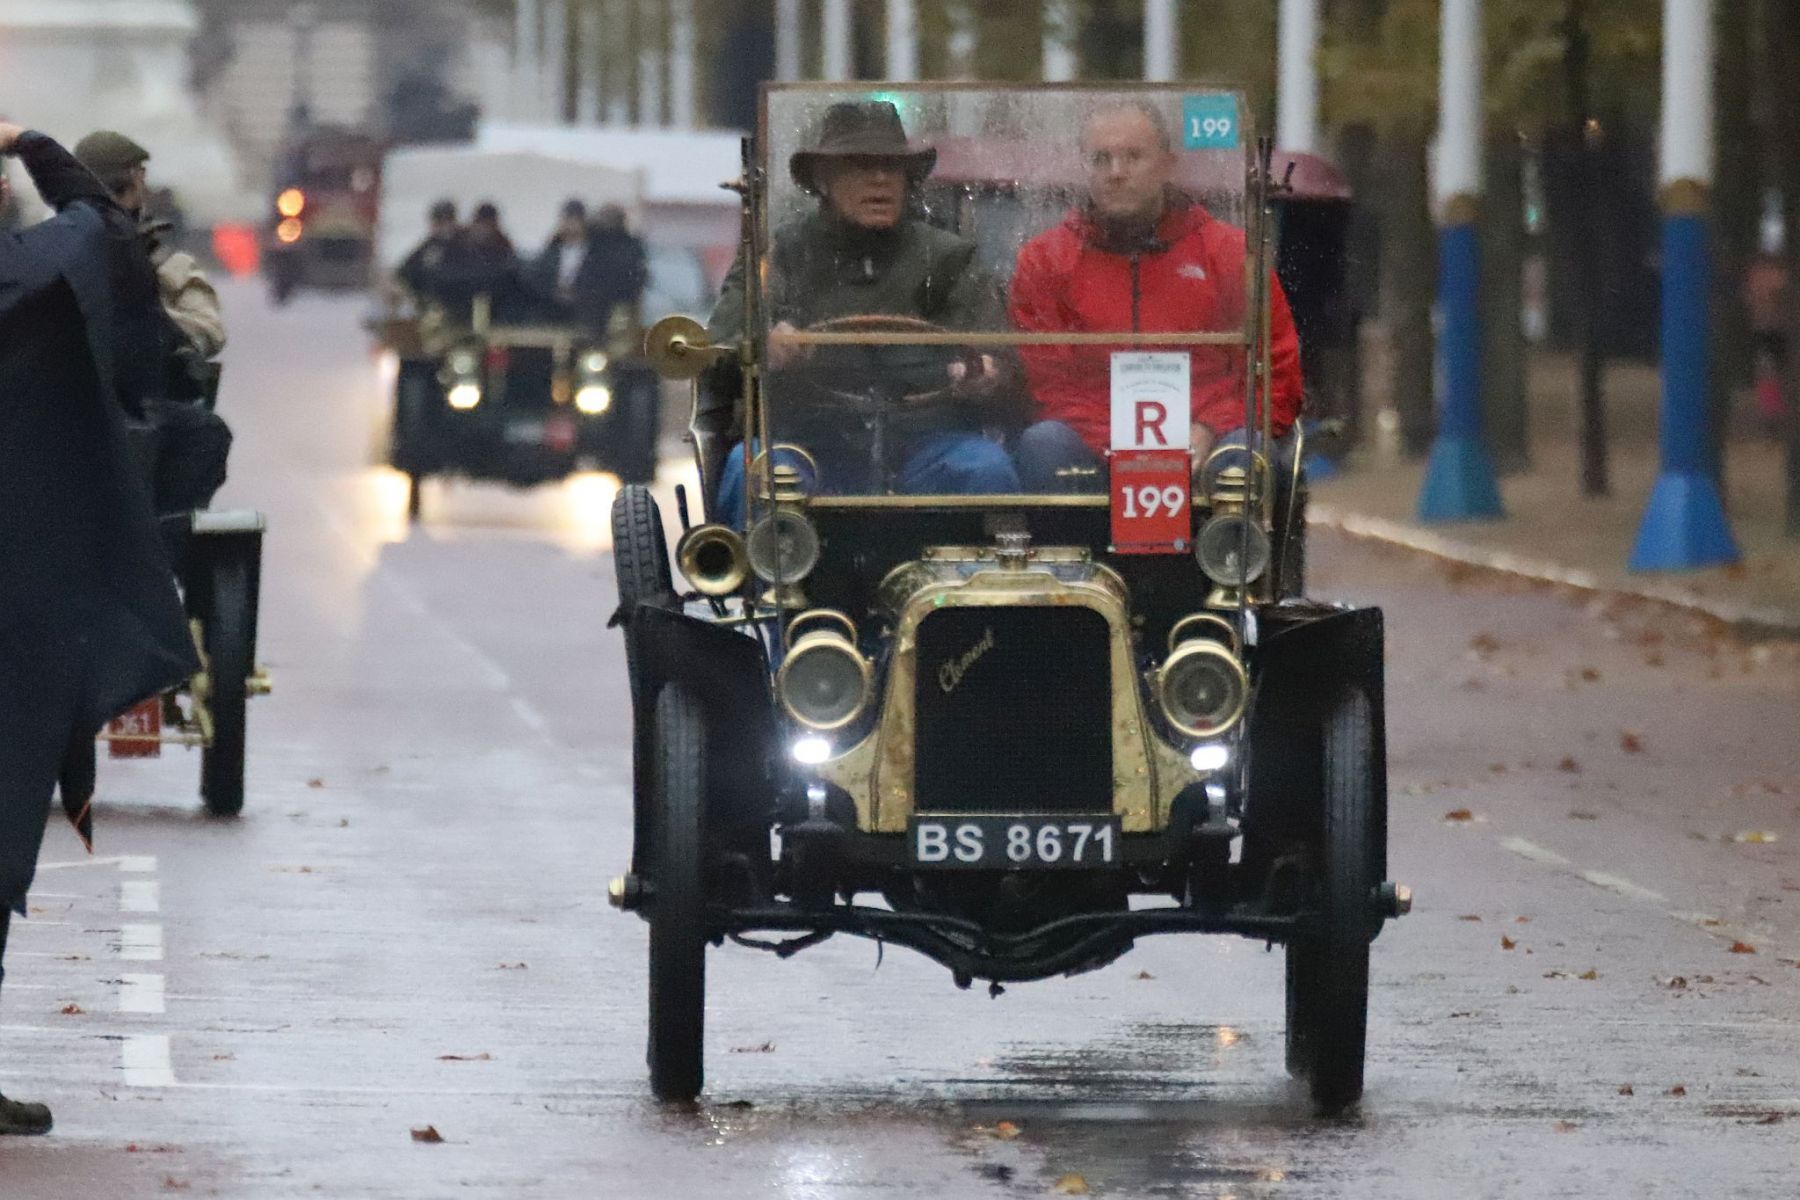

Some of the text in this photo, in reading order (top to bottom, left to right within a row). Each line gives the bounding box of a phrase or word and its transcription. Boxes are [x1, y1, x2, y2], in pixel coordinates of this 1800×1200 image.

[1191, 117, 1231, 138] 199
[1134, 401, 1168, 446] R
[1121, 485, 1185, 518] 199
[917, 825, 1113, 862] BS 8671
